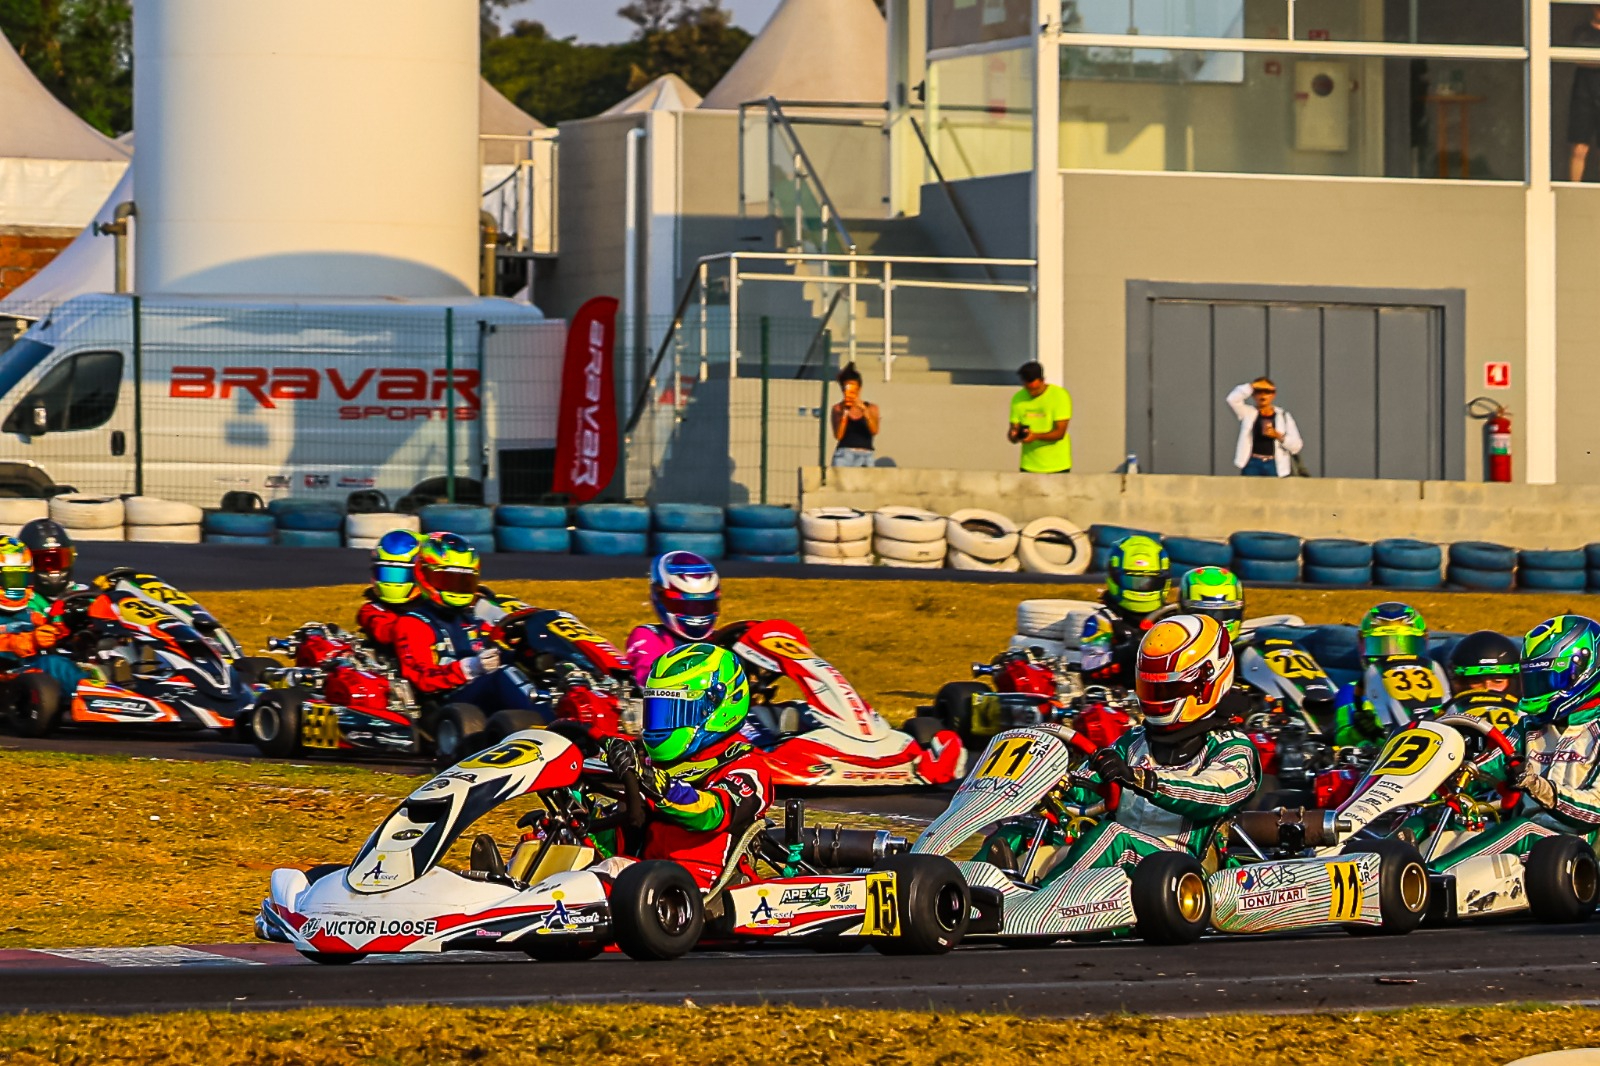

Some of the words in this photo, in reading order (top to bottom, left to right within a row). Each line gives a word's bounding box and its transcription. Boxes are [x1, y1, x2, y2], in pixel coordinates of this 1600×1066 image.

[338, 406, 478, 421] SPORTS
[1273, 654, 1318, 674] 20
[1392, 670, 1433, 691] 33
[982, 740, 1034, 777] 11
[1028, 749, 1047, 759] JR
[1356, 862, 1369, 871] F4
[1359, 872, 1371, 882] JR
[781, 887, 828, 902] APEXIS
[1241, 894, 1271, 909] TONY
[1278, 888, 1305, 903] KART
[1333, 865, 1359, 918] 11
[868, 879, 896, 934] 15
[1060, 904, 1085, 917] TONY
[1091, 900, 1119, 912] KART
[325, 920, 377, 936] VICTOR
[380, 920, 436, 936] LOOSE
